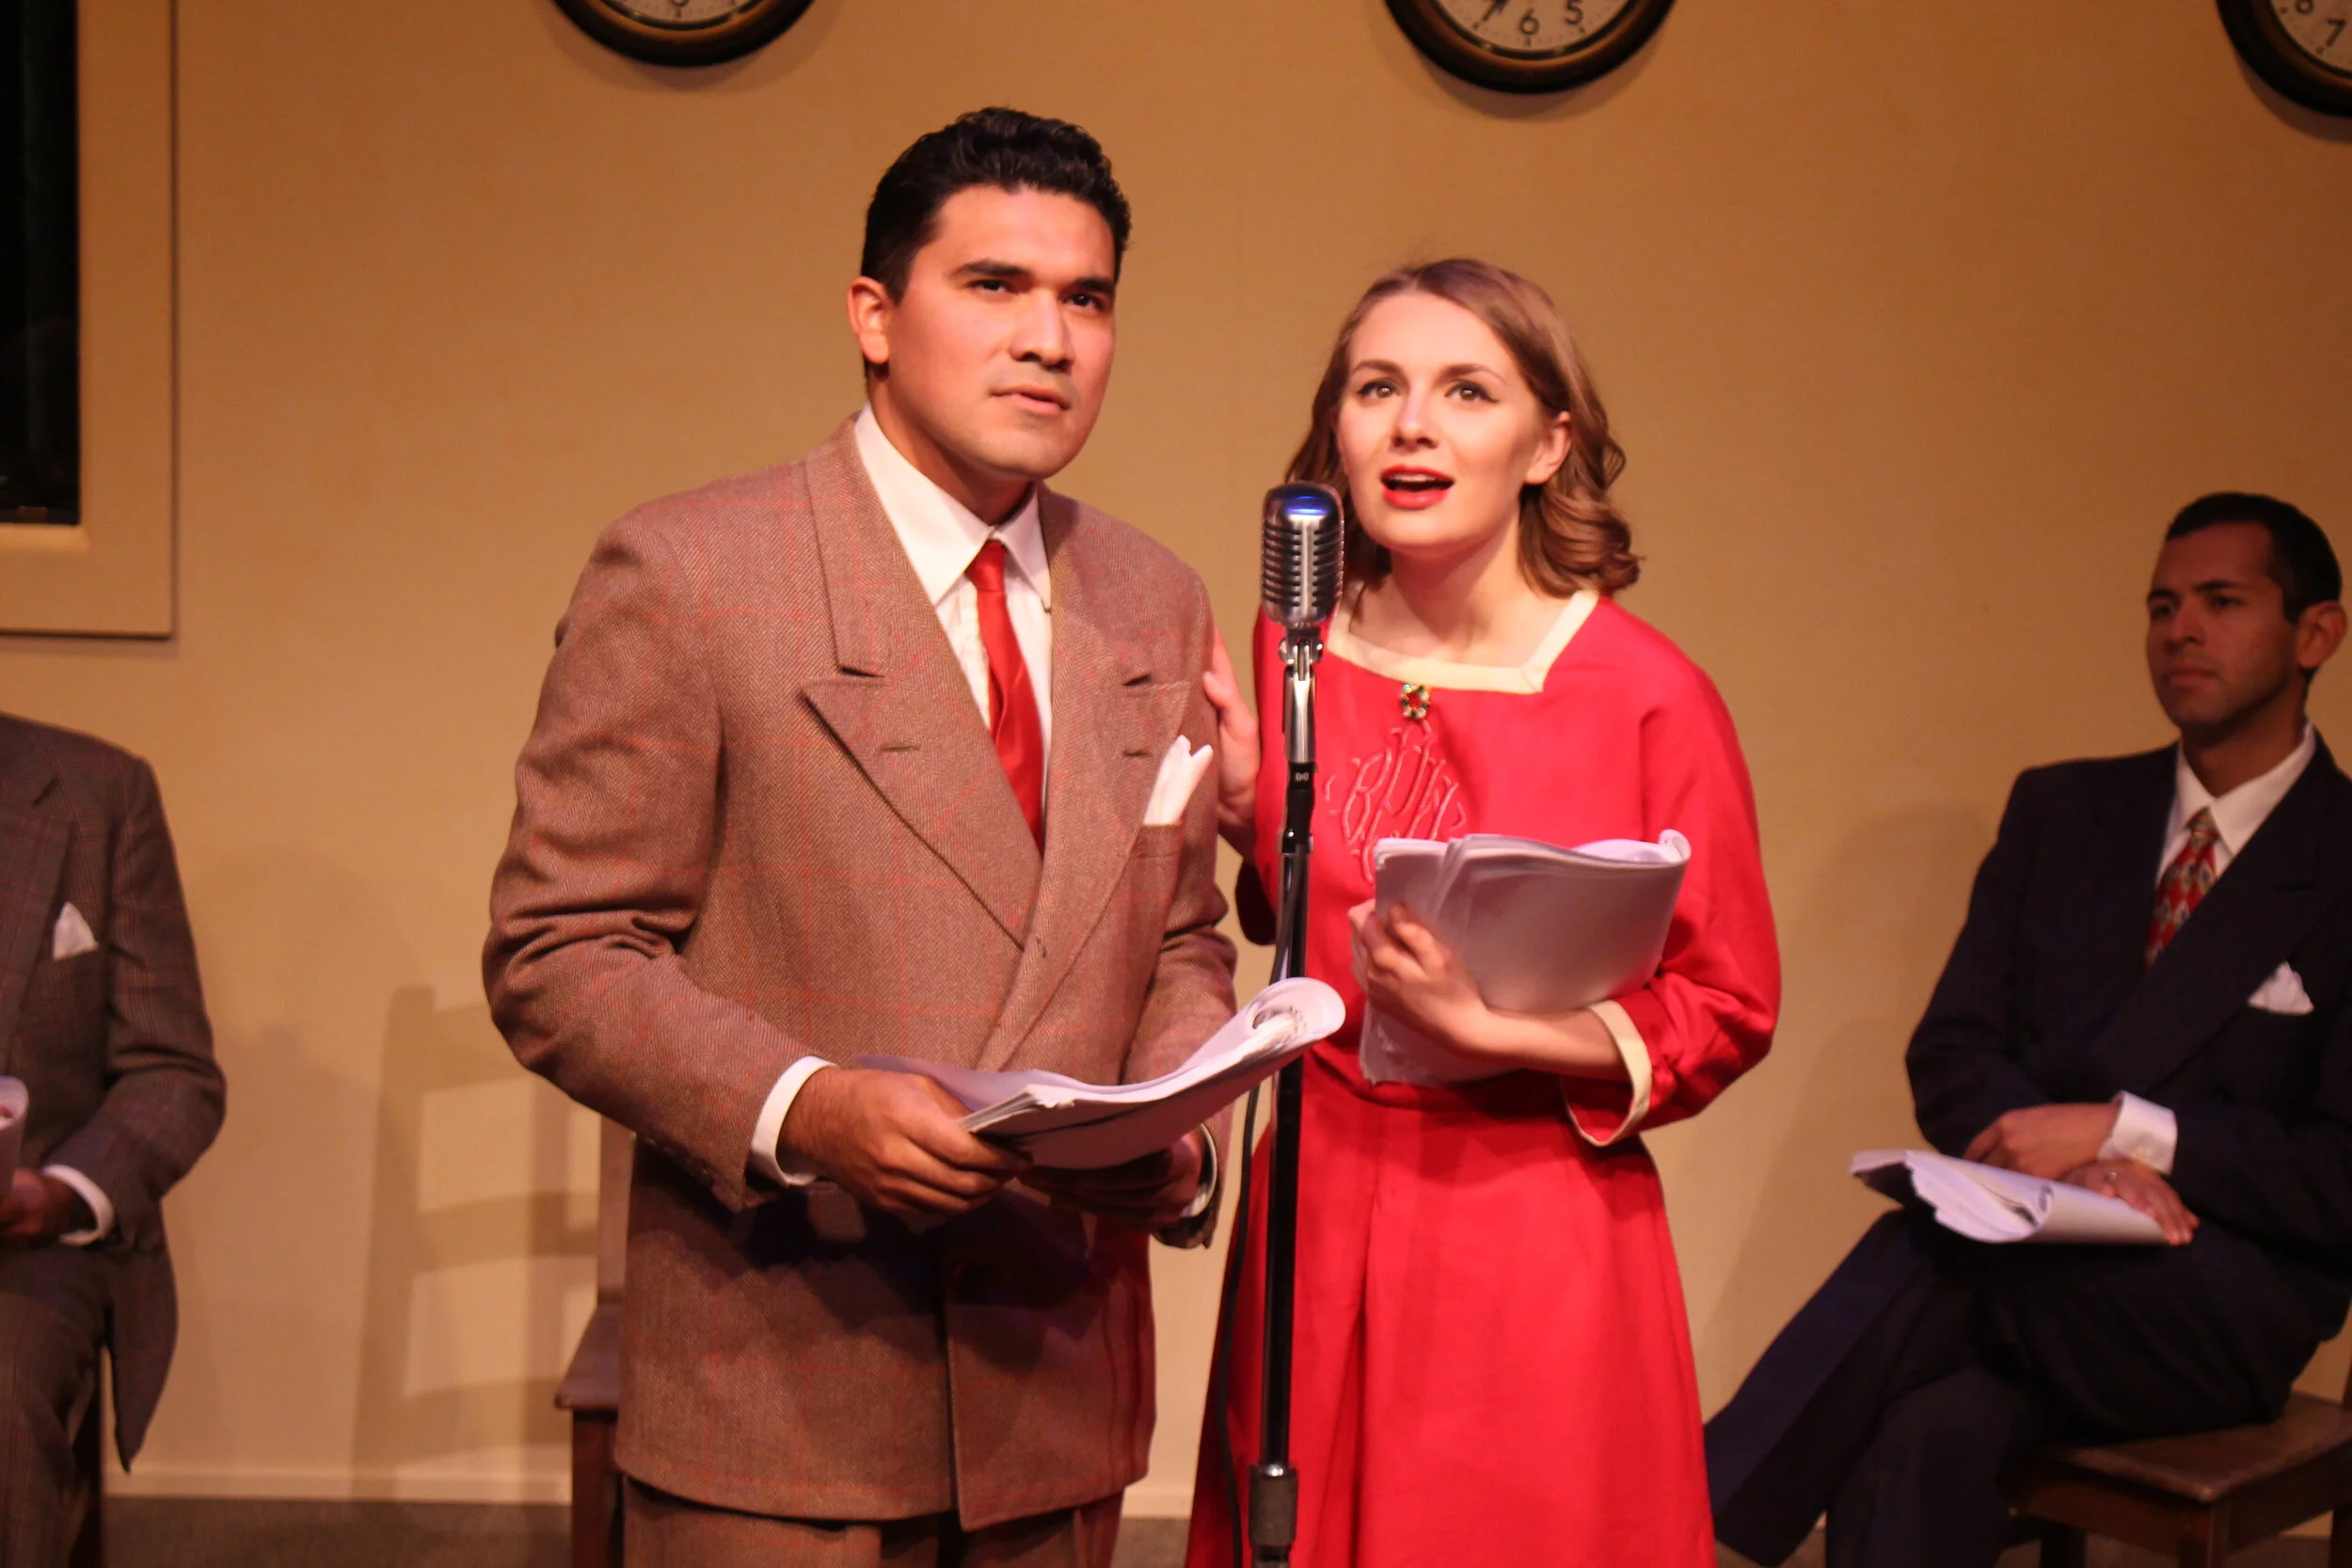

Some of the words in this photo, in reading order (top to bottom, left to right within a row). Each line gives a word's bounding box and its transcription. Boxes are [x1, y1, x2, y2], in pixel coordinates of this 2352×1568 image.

[1518, 8, 1540, 35] 6
[1564, 0, 1583, 24] 5
[2326, 18, 2347, 47] 7
